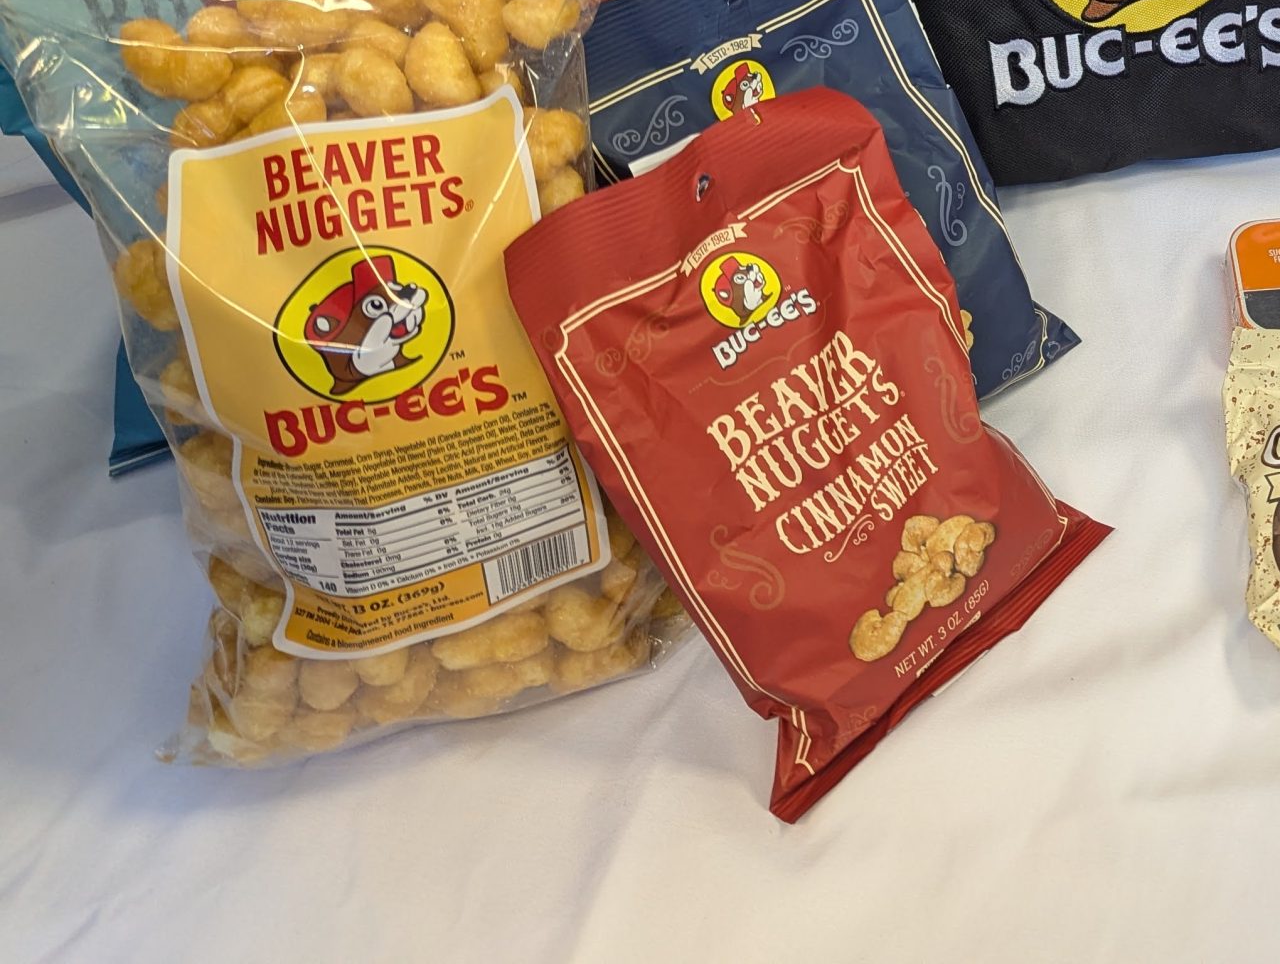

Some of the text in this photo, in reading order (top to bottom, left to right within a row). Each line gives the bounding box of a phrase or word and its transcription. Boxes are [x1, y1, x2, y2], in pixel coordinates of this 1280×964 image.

[730, 39, 749, 52] 1982
[263, 134, 445, 202] BEAVER
[710, 230, 731, 247] 1982
[706, 330, 877, 473] BEAVER
[775, 414, 925, 555] CINNAMON
[870, 443, 939, 522] SWEET
[260, 512, 317, 525] Nutrition
[352, 602, 367, 616] 13
[370, 598, 395, 612] OZ.
[397, 581, 446, 604] (369g)
[894, 579, 990, 678] NET WT. 3 OZ. (85G)
